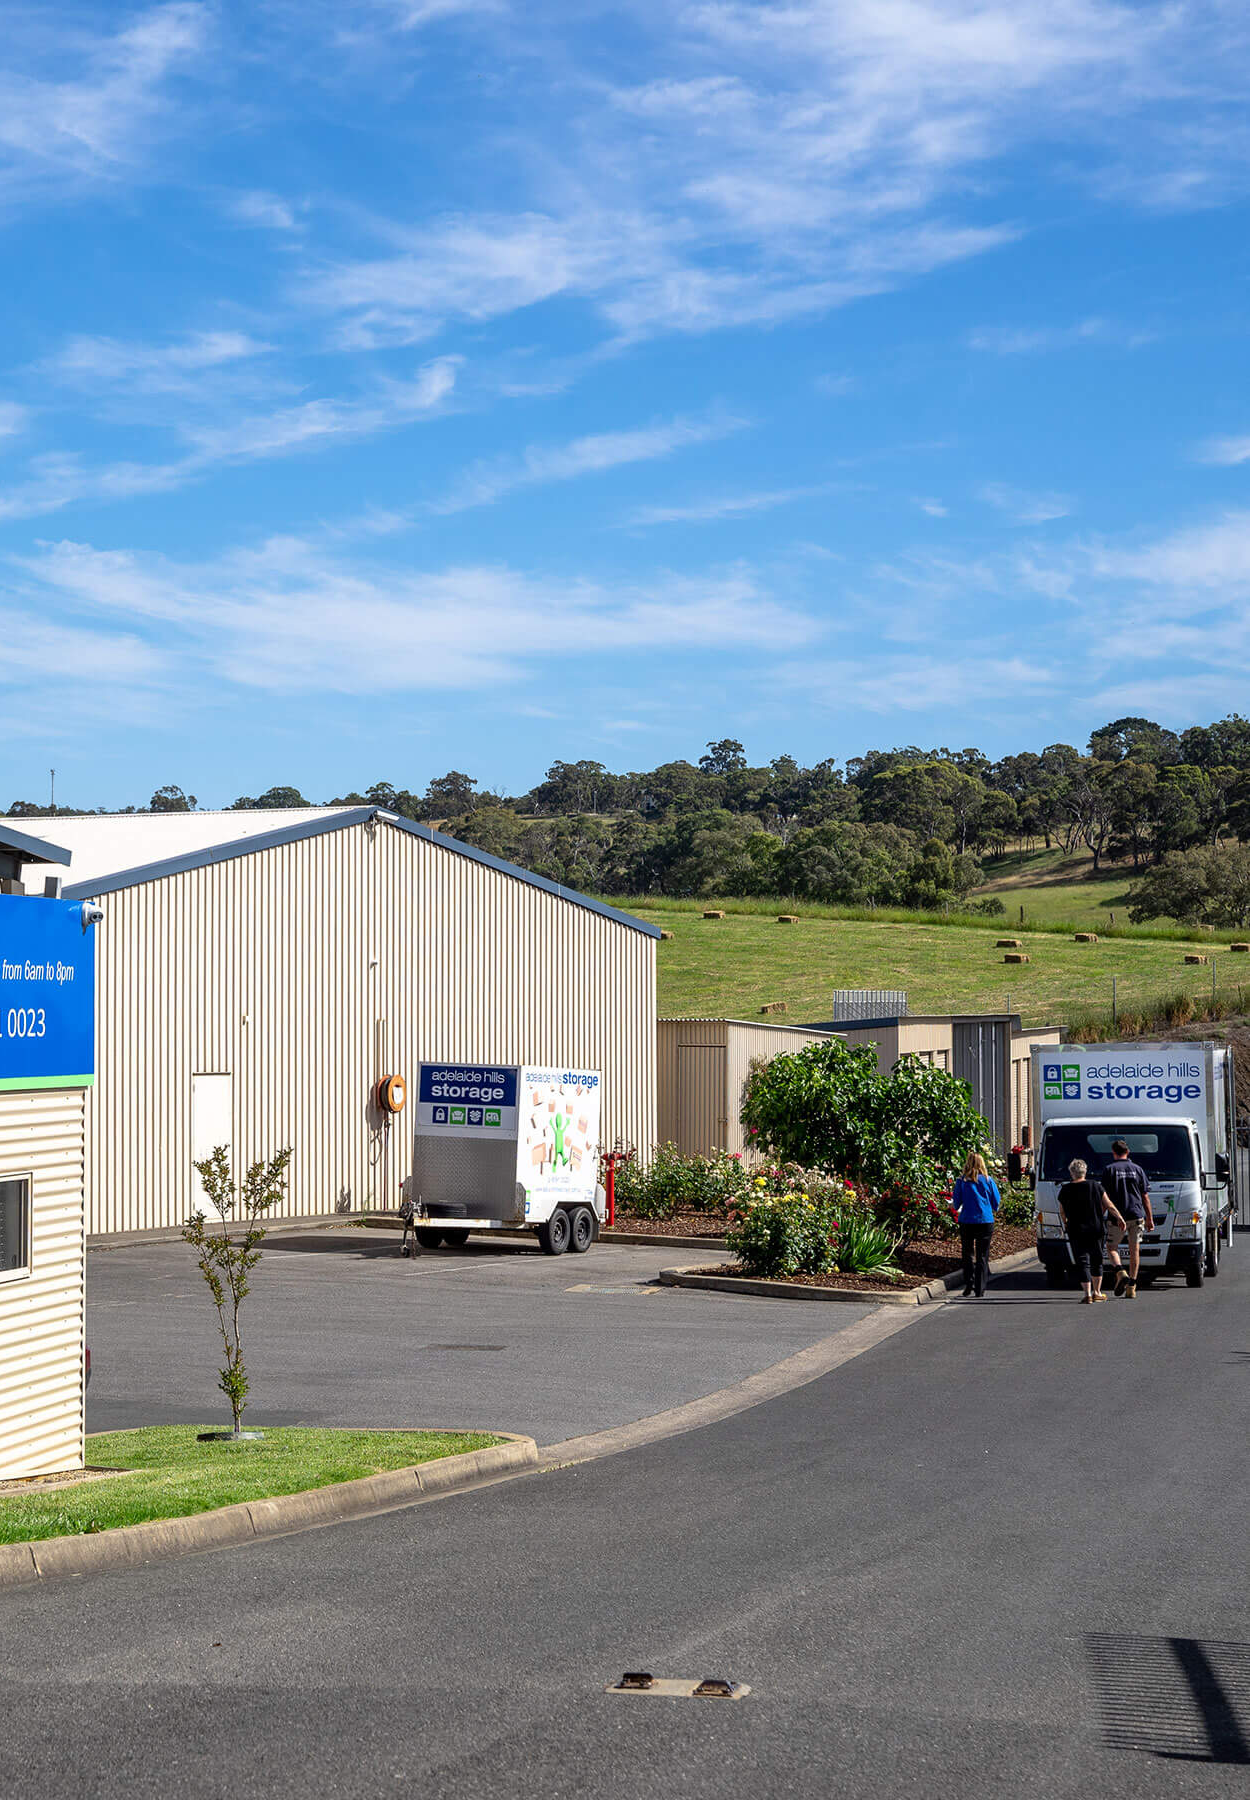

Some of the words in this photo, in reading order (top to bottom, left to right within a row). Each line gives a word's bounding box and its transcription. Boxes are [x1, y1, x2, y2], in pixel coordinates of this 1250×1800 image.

[2, 959, 22, 980] from
[24, 959, 44, 980] 6am
[45, 961, 54, 980] to
[56, 960, 75, 986] 8pm
[7, 1008, 46, 1038] 0023
[431, 1069, 482, 1083] adelaide
[484, 1071, 505, 1084] hills
[562, 1072, 598, 1089] storage
[1086, 1063, 1164, 1079] adelaide
[1167, 1062, 1200, 1078] hills
[431, 1083, 505, 1103] storage
[1087, 1082, 1201, 1104] storage
